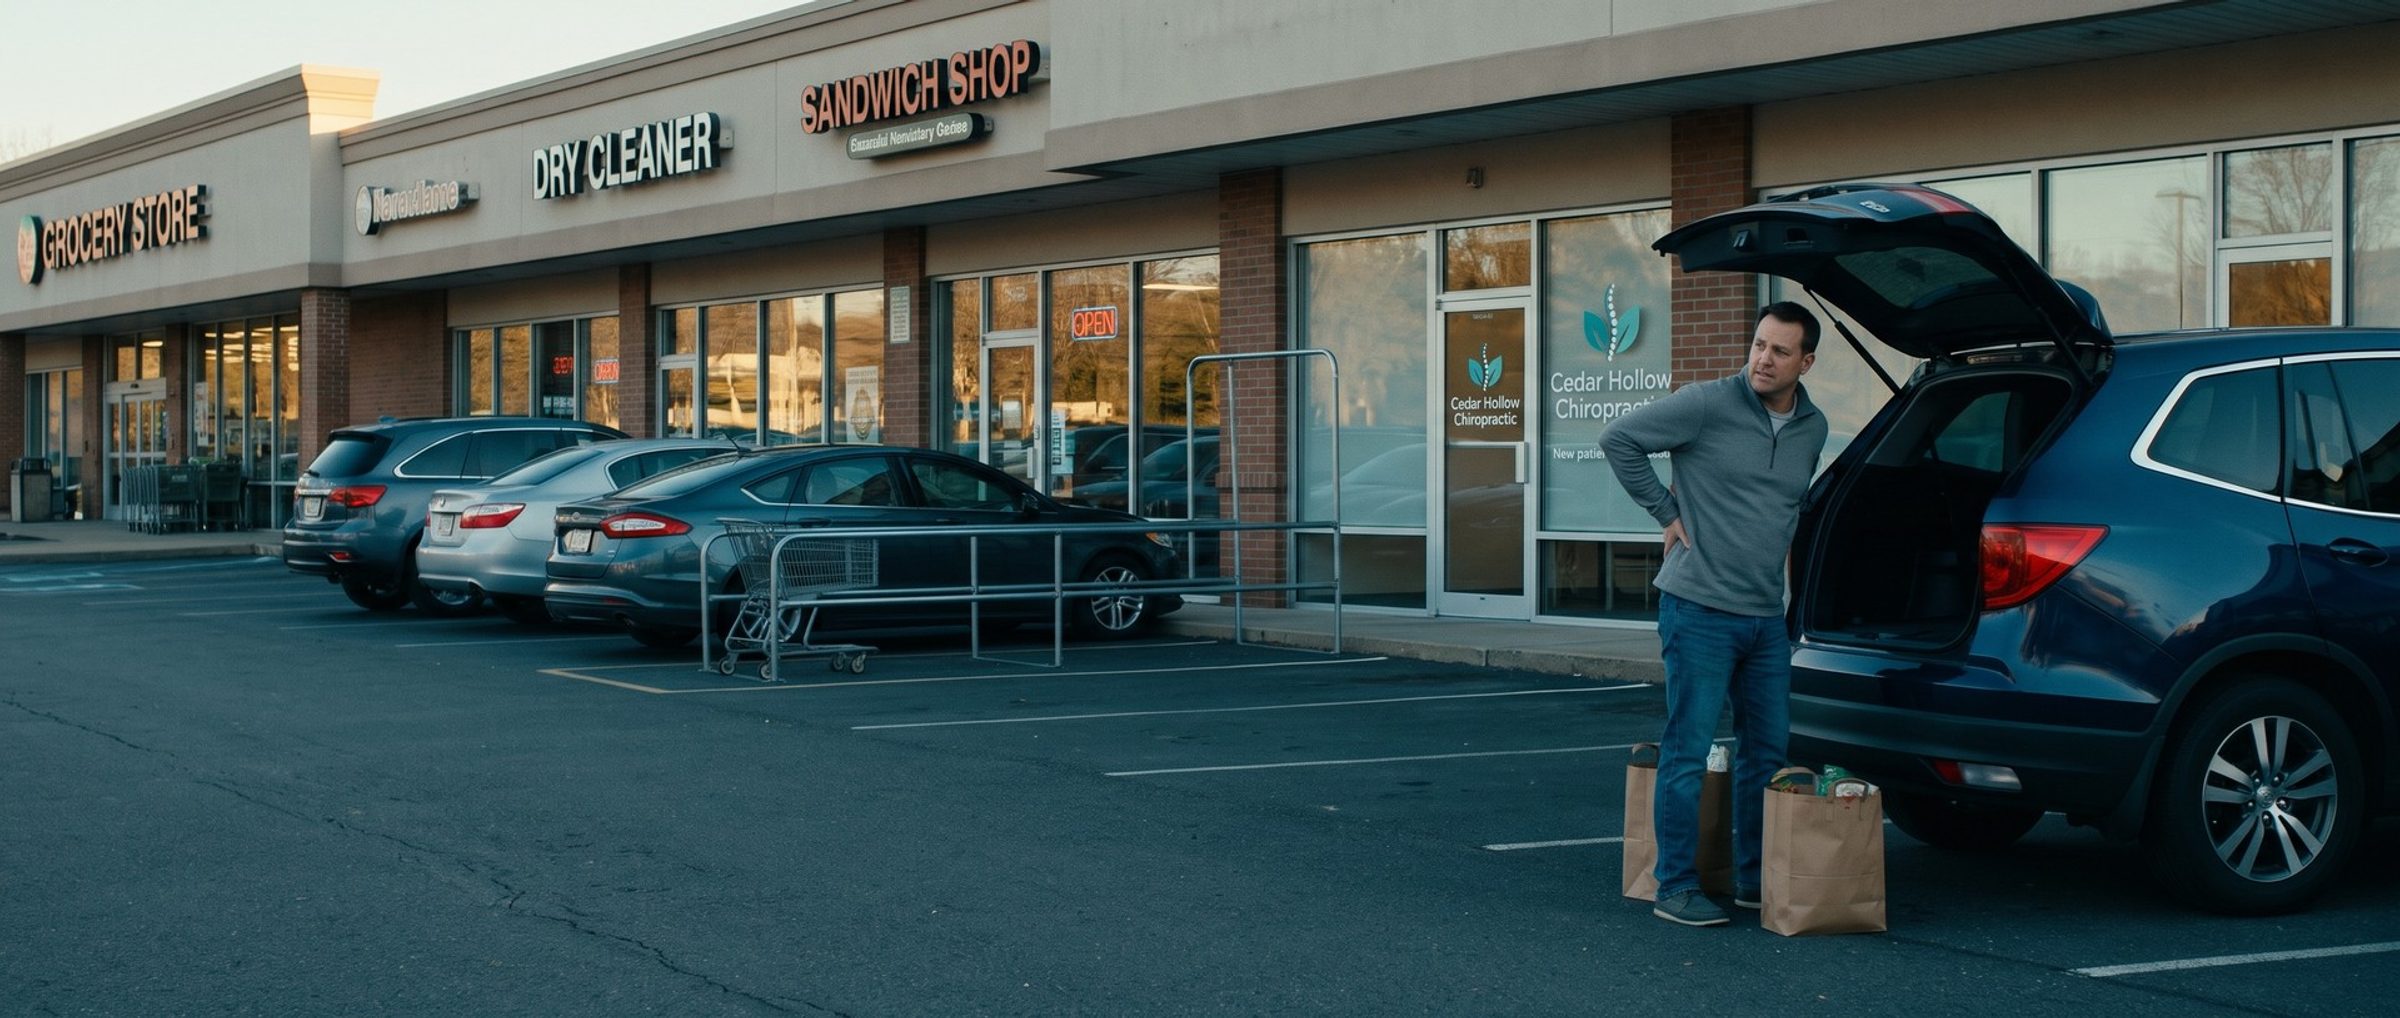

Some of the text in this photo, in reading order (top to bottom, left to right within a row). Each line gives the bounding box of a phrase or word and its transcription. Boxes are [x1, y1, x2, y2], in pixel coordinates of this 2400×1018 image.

[801, 39, 1031, 134] SANDWICH SHOP
[533, 112, 714, 200] DRY CLEANER
[42, 203, 128, 270] GROCERY
[131, 184, 201, 251] STORE
[1073, 310, 1115, 337] OPEN
[1551, 368, 1672, 393] Cedar Hollow
[1450, 395, 1520, 411] Cedar Hollow
[1555, 395, 1655, 424] Chiropra
[1454, 411, 1518, 428] Chiropractic
[1553, 447, 1575, 459] New
